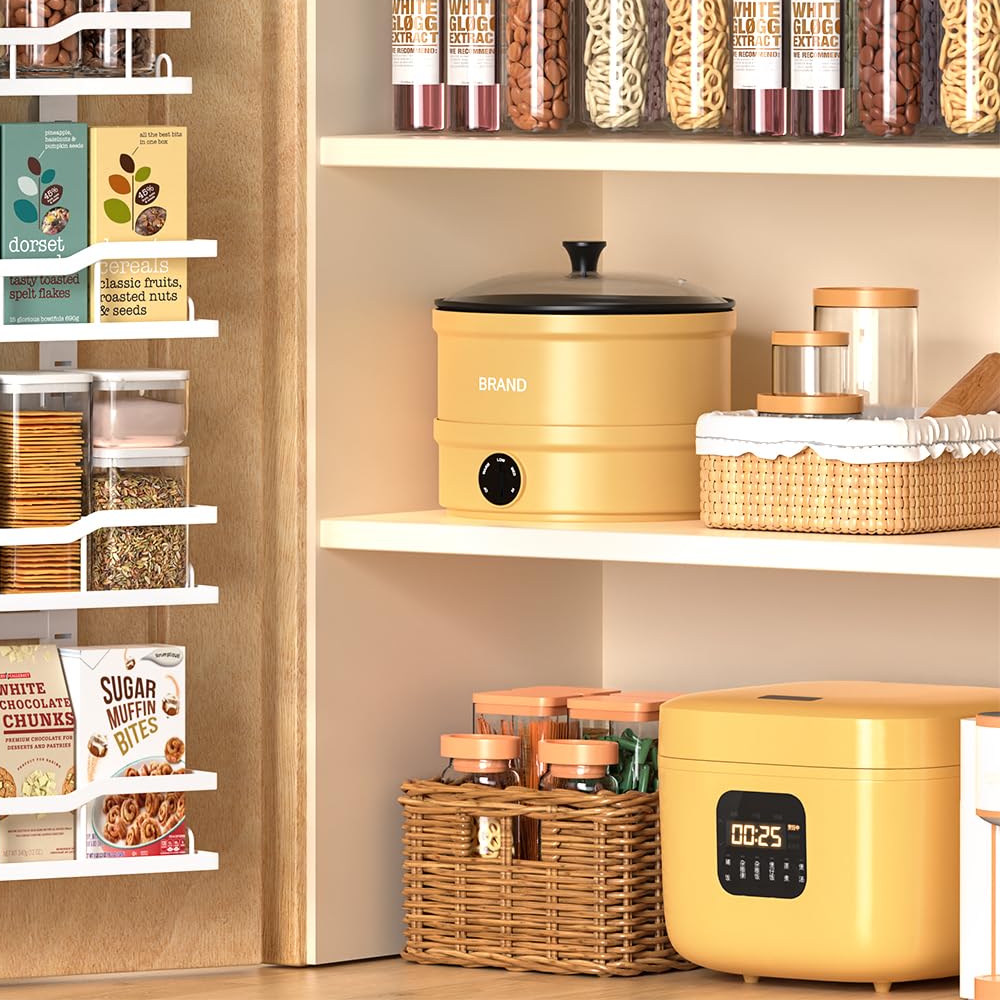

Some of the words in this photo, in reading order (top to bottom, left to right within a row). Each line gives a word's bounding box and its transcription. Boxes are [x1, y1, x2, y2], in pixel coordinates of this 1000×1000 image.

[8, 236, 64, 252] dorset
[100, 260, 169, 274] cereals
[10, 276, 36, 288] tasty
[40, 274, 80, 285] toasted
[100, 278, 141, 288] classic
[144, 277, 182, 289] fruits,
[10, 288, 36, 301] spelt
[39, 288, 70, 298] flakes
[100, 291, 145, 302] roasted
[150, 292, 178, 302] nuts
[100, 305, 110, 316] &
[112, 304, 147, 316] seeds
[478, 376, 527, 393] BRAND
[100, 676, 156, 705] SUGAR
[0, 698, 72, 710] CHOCOLATE
[3, 712, 74, 728] CHUNKS
[106, 701, 156, 730] MUFFIN
[114, 717, 158, 756] BITES
[731, 823, 782, 848] 00:25
